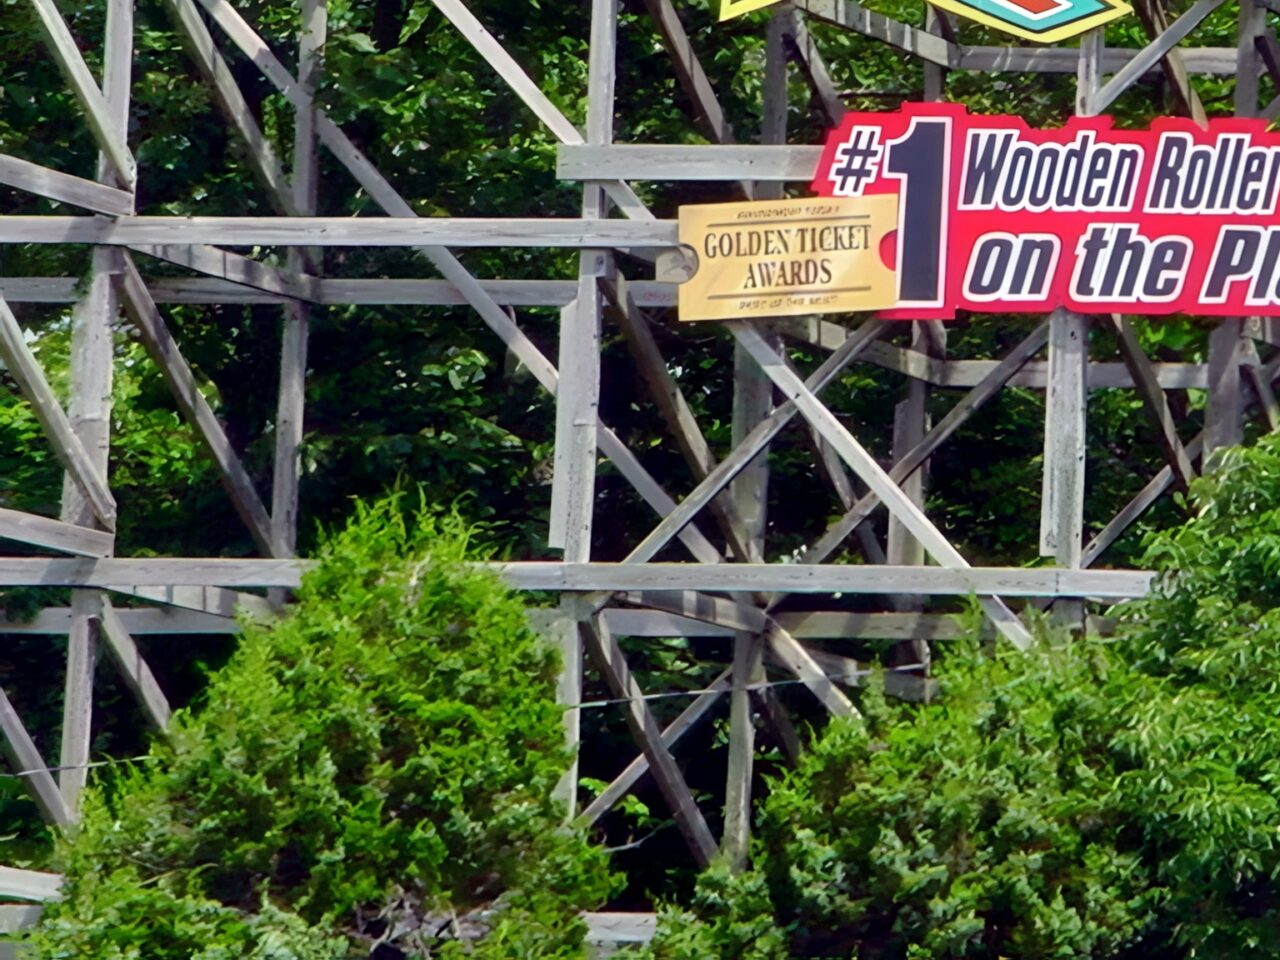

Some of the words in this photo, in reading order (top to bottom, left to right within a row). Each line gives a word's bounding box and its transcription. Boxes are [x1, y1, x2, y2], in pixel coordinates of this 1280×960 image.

[829, 116, 952, 307] #1
[959, 129, 1144, 211] Wooden
[704, 229, 792, 258] GOLDEN
[796, 224, 871, 251] TICKET
[962, 233, 1060, 301] on
[1070, 223, 1193, 302] the
[744, 259, 832, 288] AWARDS
